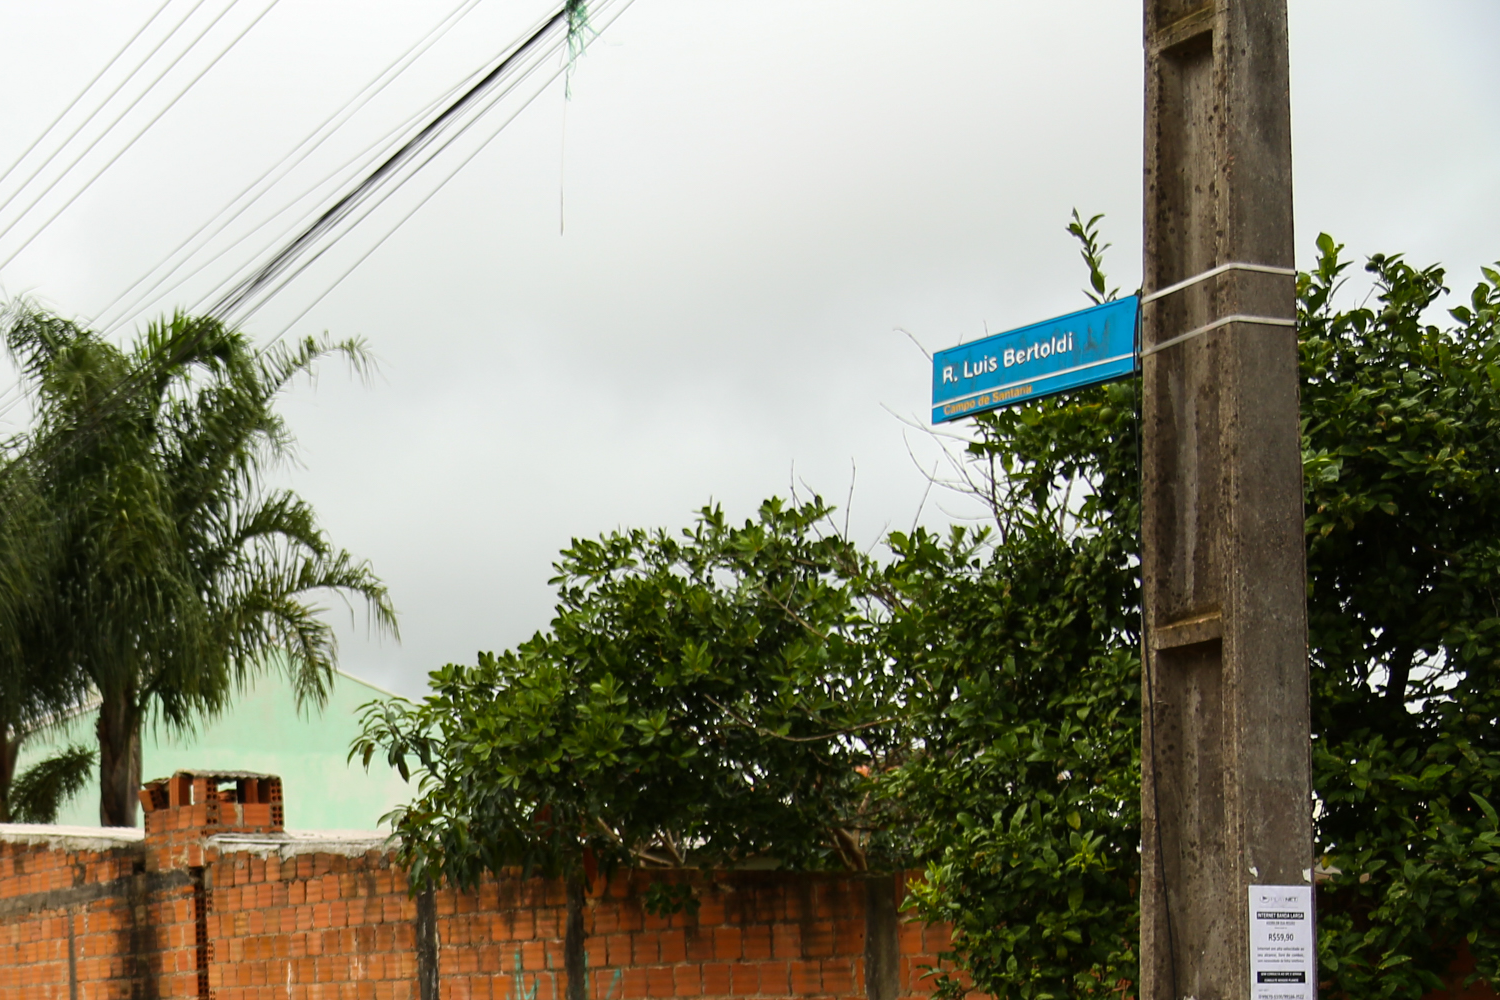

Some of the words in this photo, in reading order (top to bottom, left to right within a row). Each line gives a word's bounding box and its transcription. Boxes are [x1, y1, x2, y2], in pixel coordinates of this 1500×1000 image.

[942, 365, 958, 384] R.
[963, 355, 998, 379] Luis
[1003, 331, 1073, 368] Bertoldi
[943, 399, 976, 415] Campo
[978, 395, 990, 406] de
[993, 385, 1033, 402] Santana
[1268, 932, 1294, 942] R$59,90
